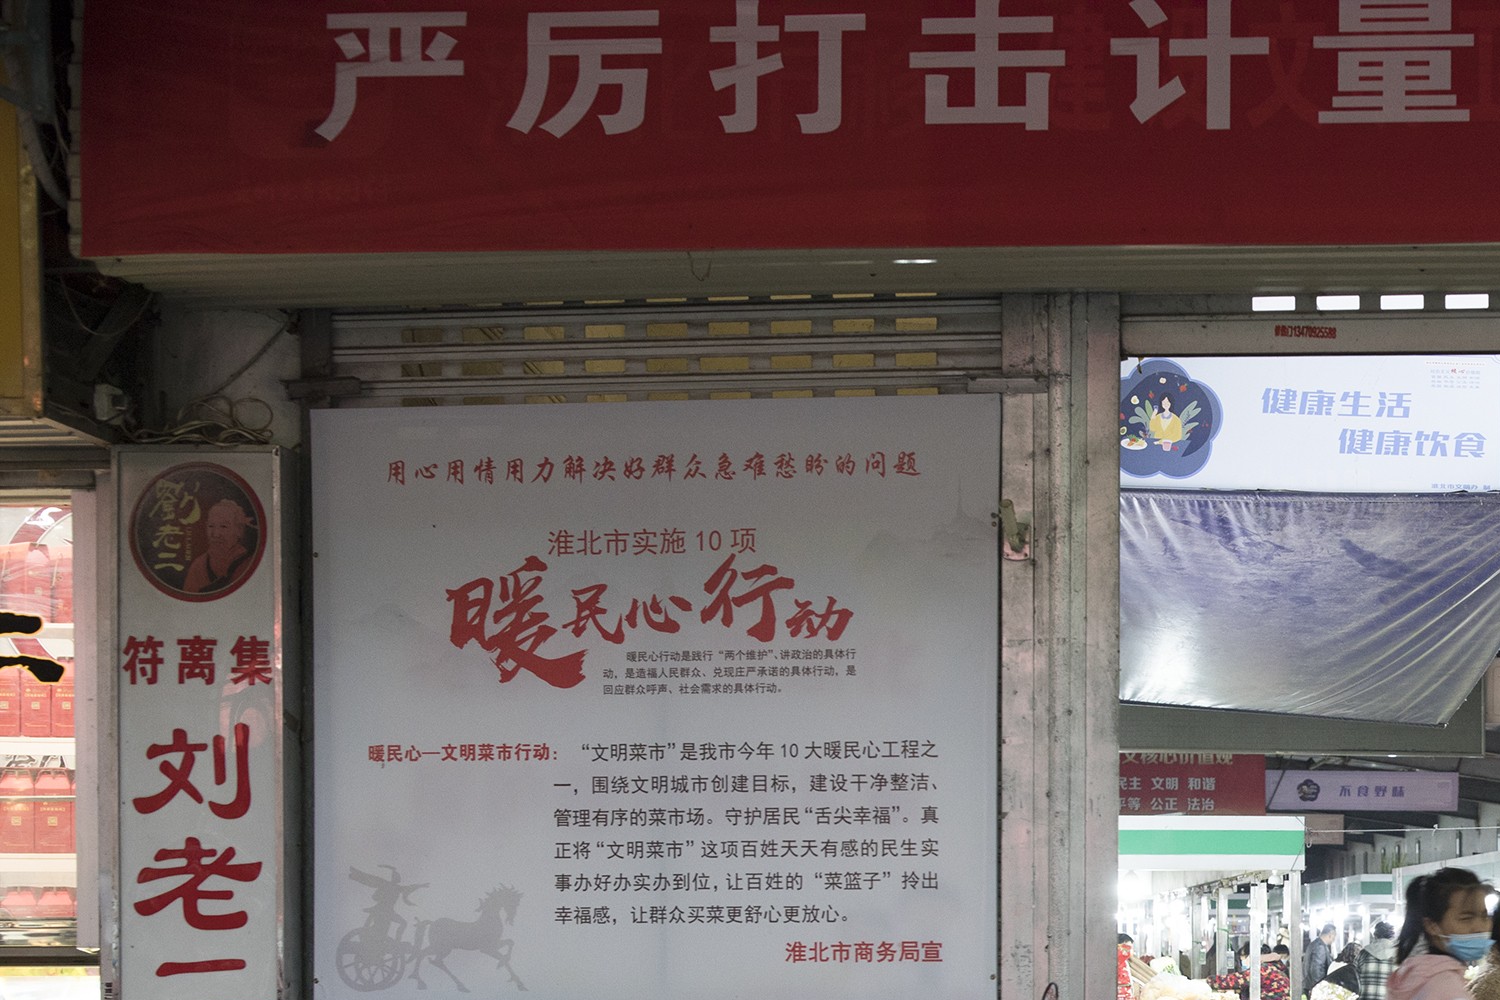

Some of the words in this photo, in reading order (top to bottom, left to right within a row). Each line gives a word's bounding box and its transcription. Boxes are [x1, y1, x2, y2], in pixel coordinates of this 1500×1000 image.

[1262, 388, 1413, 419] 健康生活
[1338, 428, 1488, 459] 健康饮食
[386, 452, 922, 485] 用心用情用力解决好群众急难愁盼的问题
[446, 553, 855, 689] 暖民心行动
[123, 633, 274, 686] 符离集
[1151, 777, 1179, 791] 文明
[1187, 777, 1216, 791] 和谐
[1150, 797, 1178, 811] 公正
[1187, 797, 1215, 811] 法治
[785, 940, 943, 964] 淮北市商务局宣
